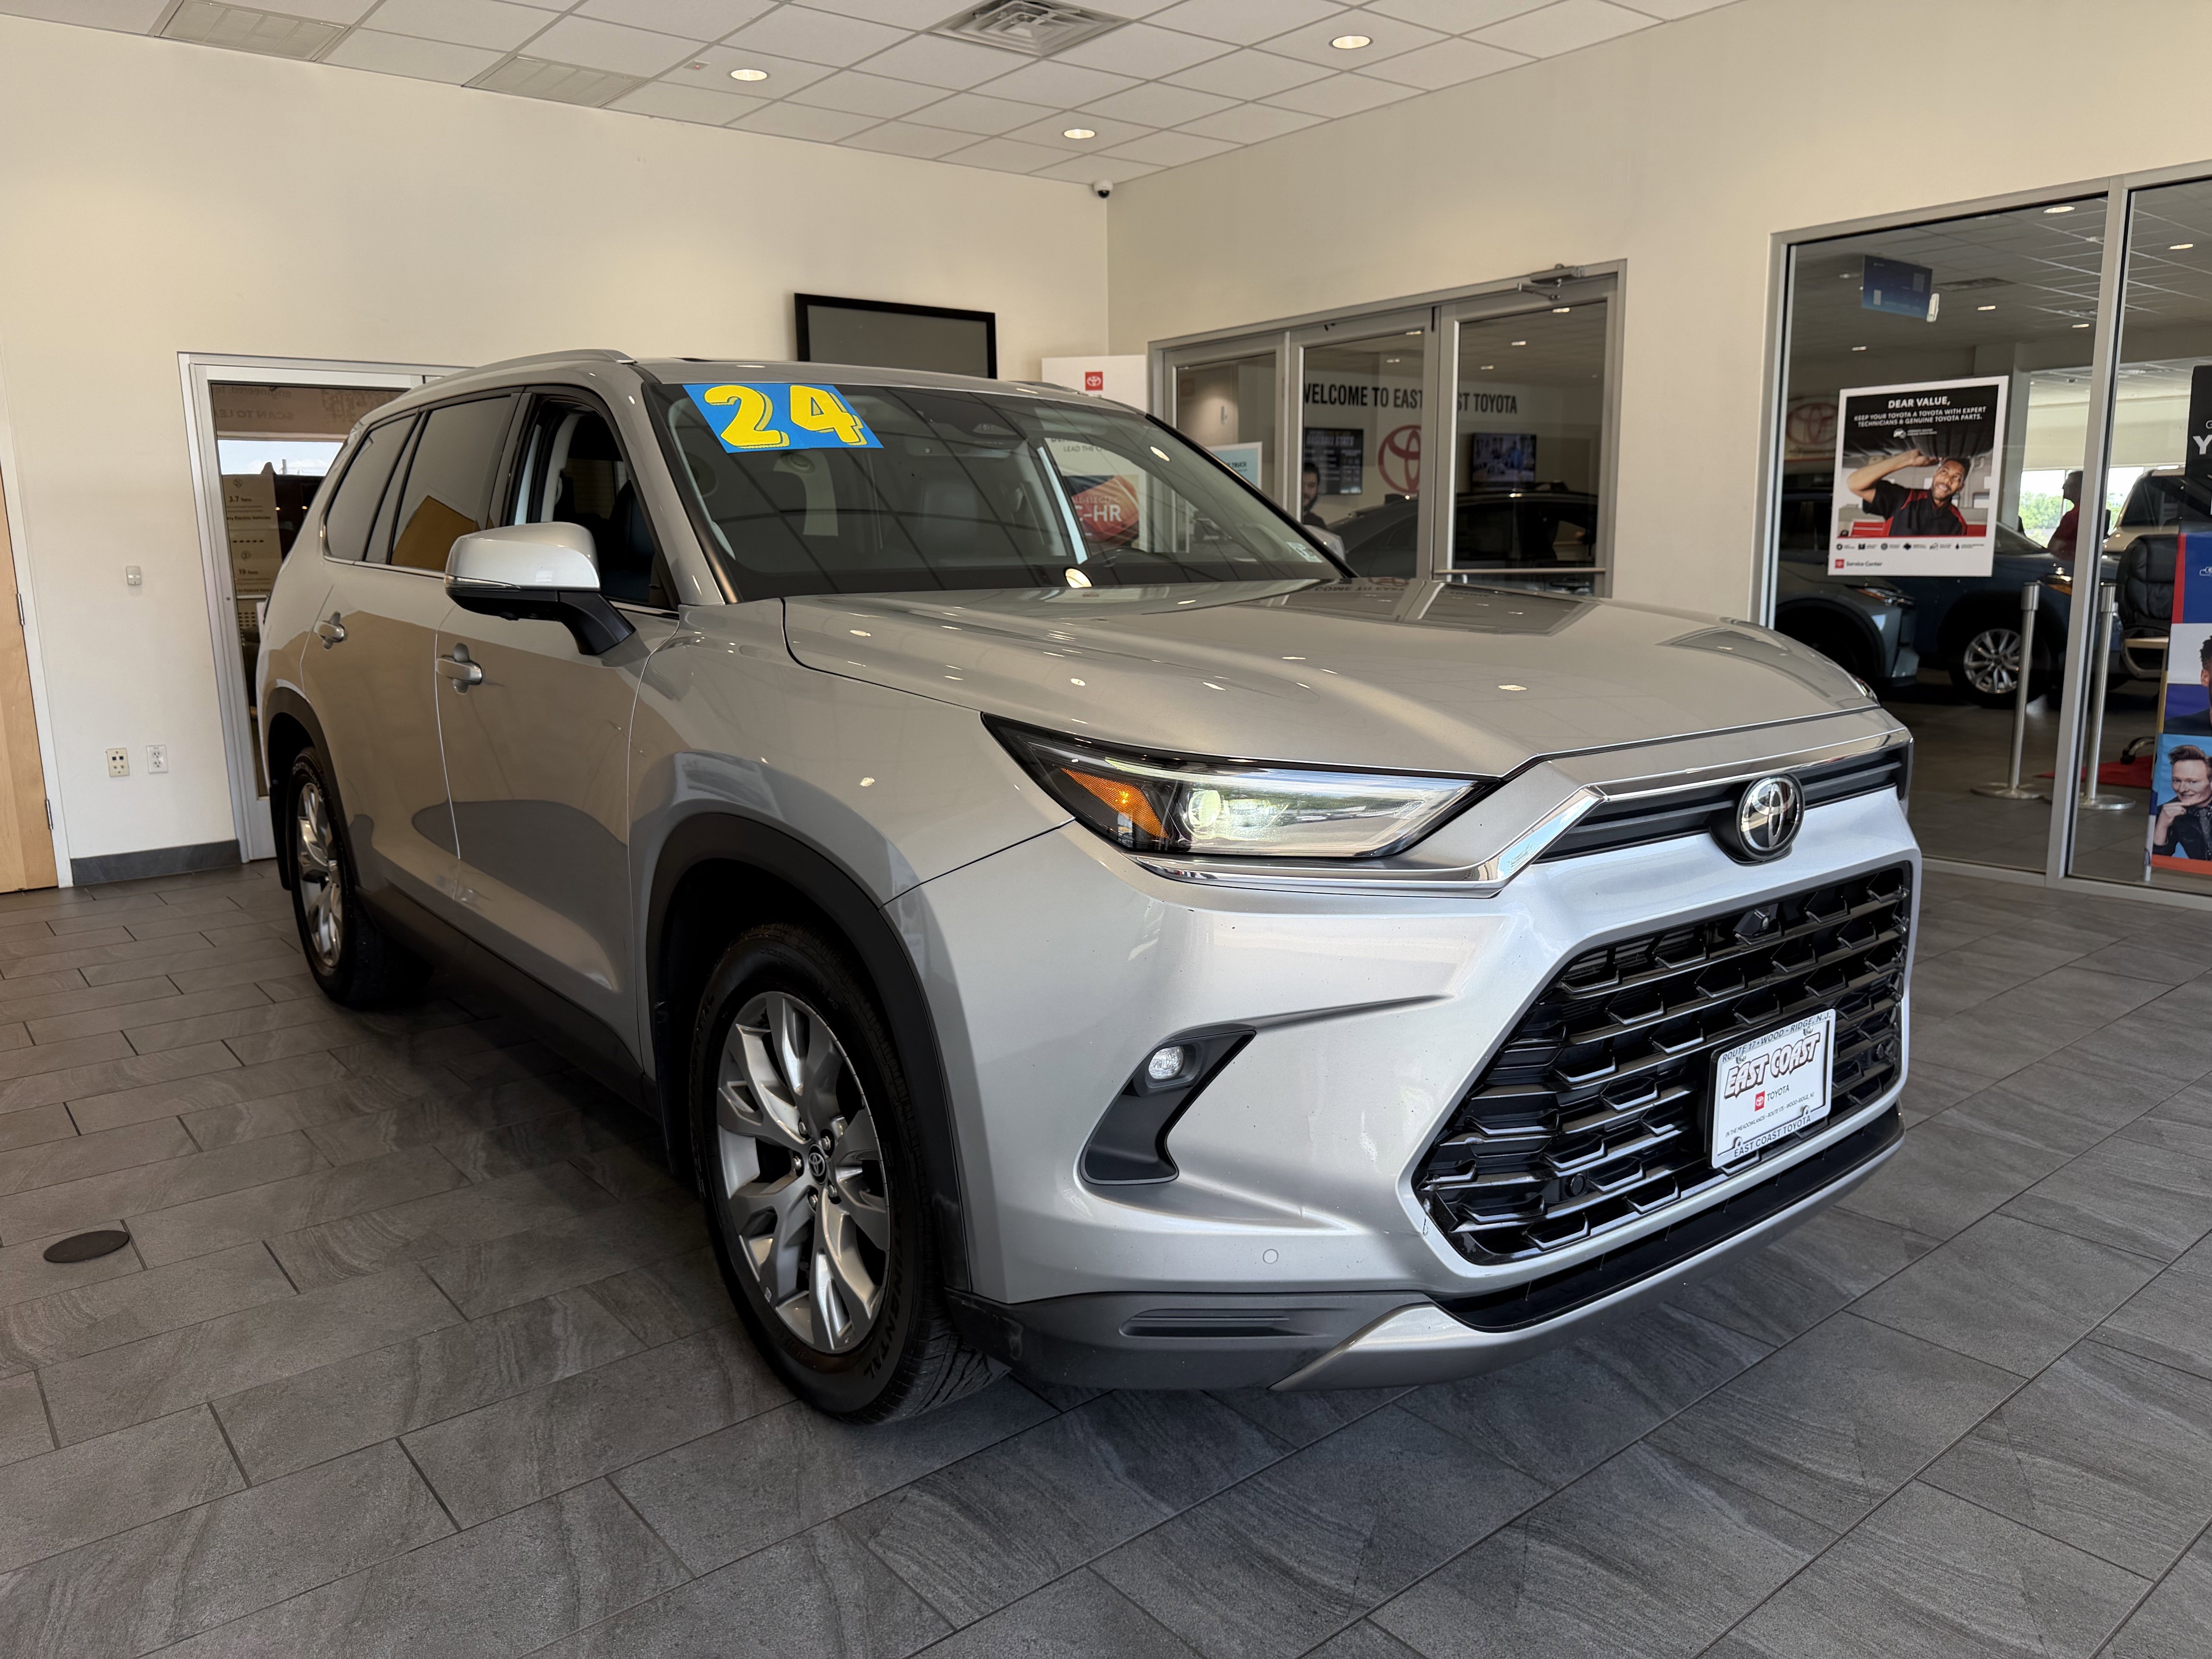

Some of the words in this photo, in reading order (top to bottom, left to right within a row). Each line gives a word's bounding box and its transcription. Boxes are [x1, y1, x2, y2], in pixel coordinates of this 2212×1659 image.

[1371, 387, 1388, 407] TO
[1474, 393, 1518, 414] TOYOTA
[1888, 399, 1914, 409] DEAR
[1917, 396, 1951, 406] VALUE,
[1905, 416, 1934, 424] GENUINE
[1935, 414, 1959, 422] TOYOTA
[1723, 1047, 1746, 1063] ROUTE
[1749, 1041, 1756, 1050] 17
[1761, 1029, 1784, 1044] WOOD
[1816, 1012, 1831, 1023] N.J.
[1724, 1053, 1769, 1099] EAST
[1771, 1032, 1820, 1078] COAST
[1767, 1084, 1790, 1101] TOYOTA
[1734, 1142, 1753, 1157] EAST
[1755, 1130, 1781, 1147] COAST
[1783, 1115, 1811, 1134] TOYOTA
